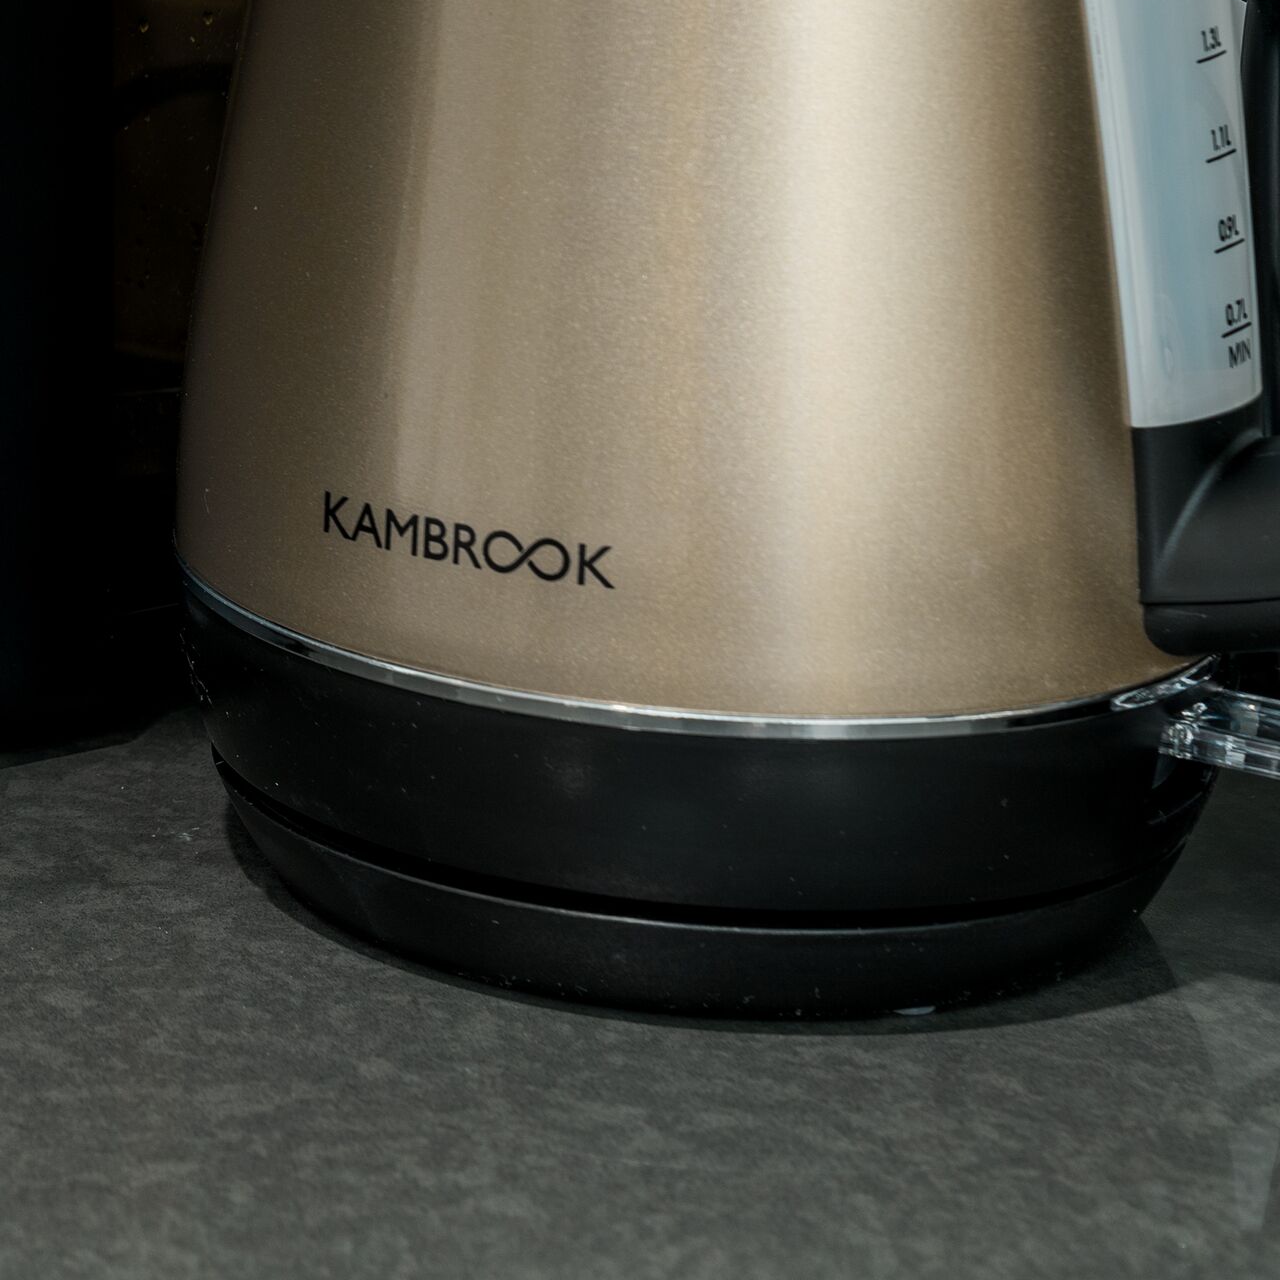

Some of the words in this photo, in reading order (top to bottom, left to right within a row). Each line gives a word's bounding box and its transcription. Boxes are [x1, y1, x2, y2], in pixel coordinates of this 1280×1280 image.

[1201, 25, 1221, 52] 1.3L
[1225, 298, 1248, 326] 0.7L
[1228, 338, 1251, 368] MIN
[323, 490, 616, 590] KAMBROOK
